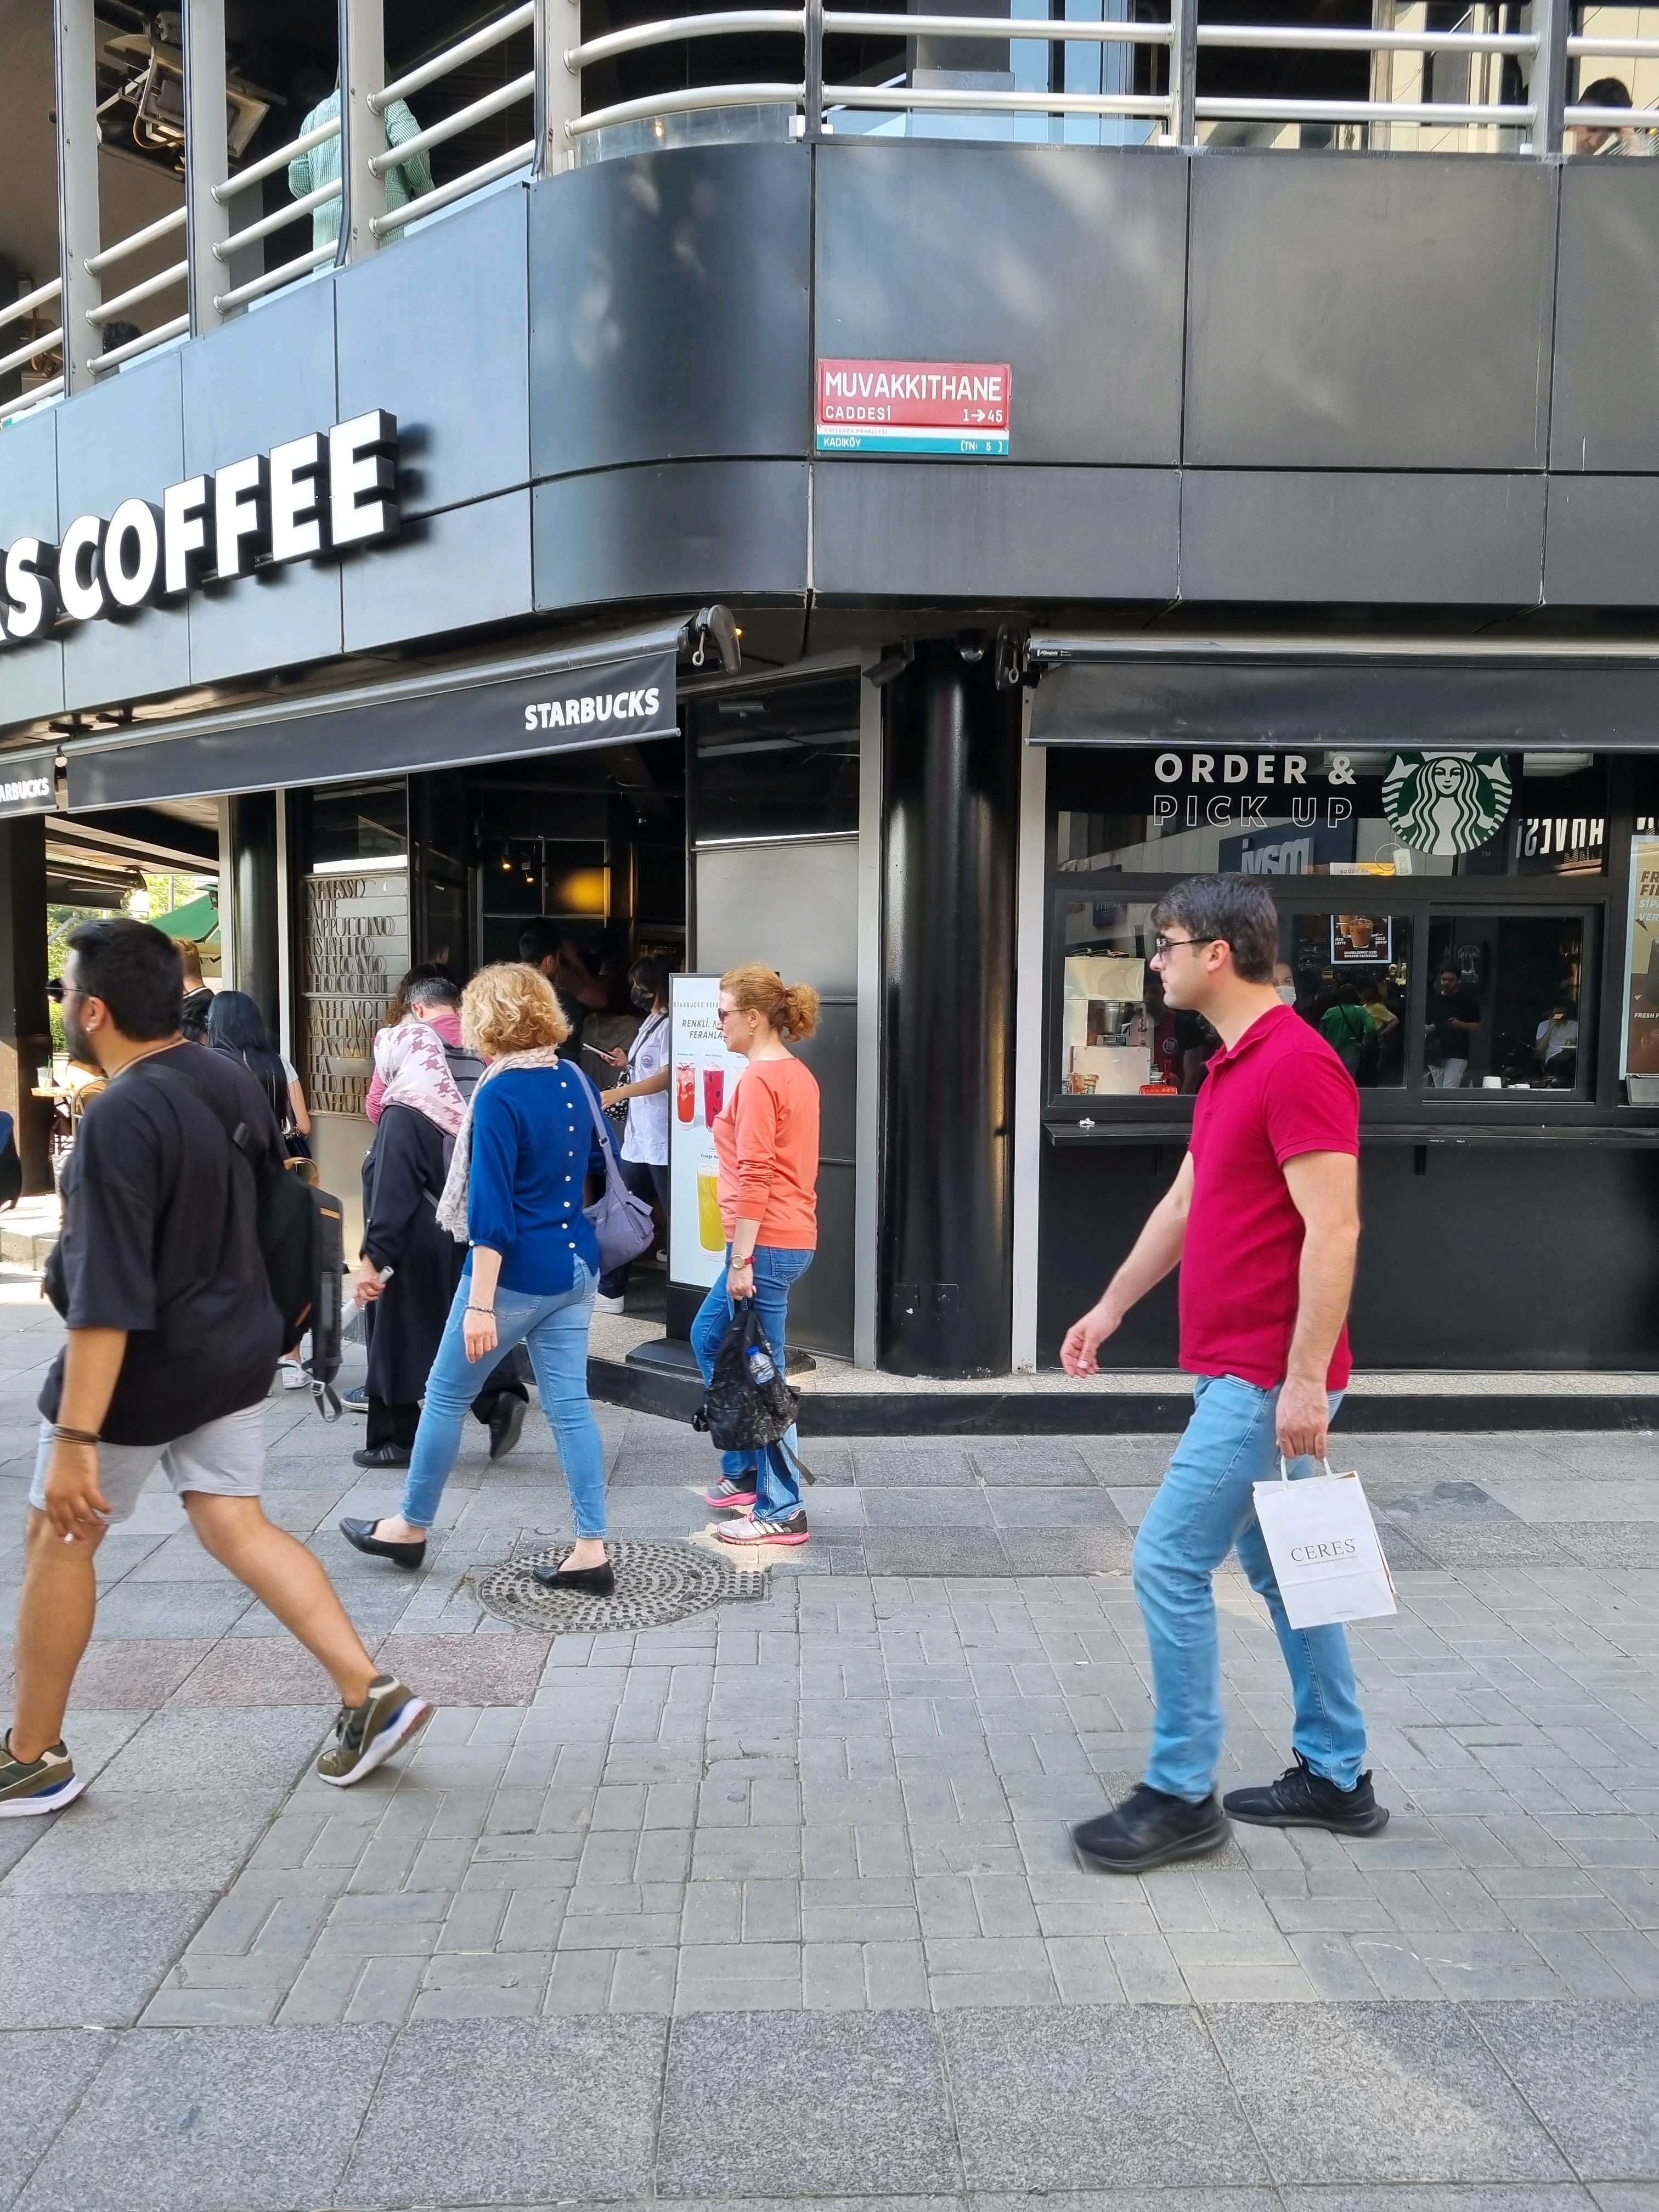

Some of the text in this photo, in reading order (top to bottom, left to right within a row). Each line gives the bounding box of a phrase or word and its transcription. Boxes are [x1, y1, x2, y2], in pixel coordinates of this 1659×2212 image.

[825, 371, 1002, 401] MUVAKKITHANE
[825, 405, 891, 420] CADDESİ
[823, 437, 861, 447] KADIKÖY
[59, 408, 399, 620] COFFEE
[524, 687, 659, 731] STARBUCKS
[1154, 753, 1307, 785] ORDER
[1153, 795, 1353, 828] PICK UP
[1291, 1538, 1356, 1562] CERES
